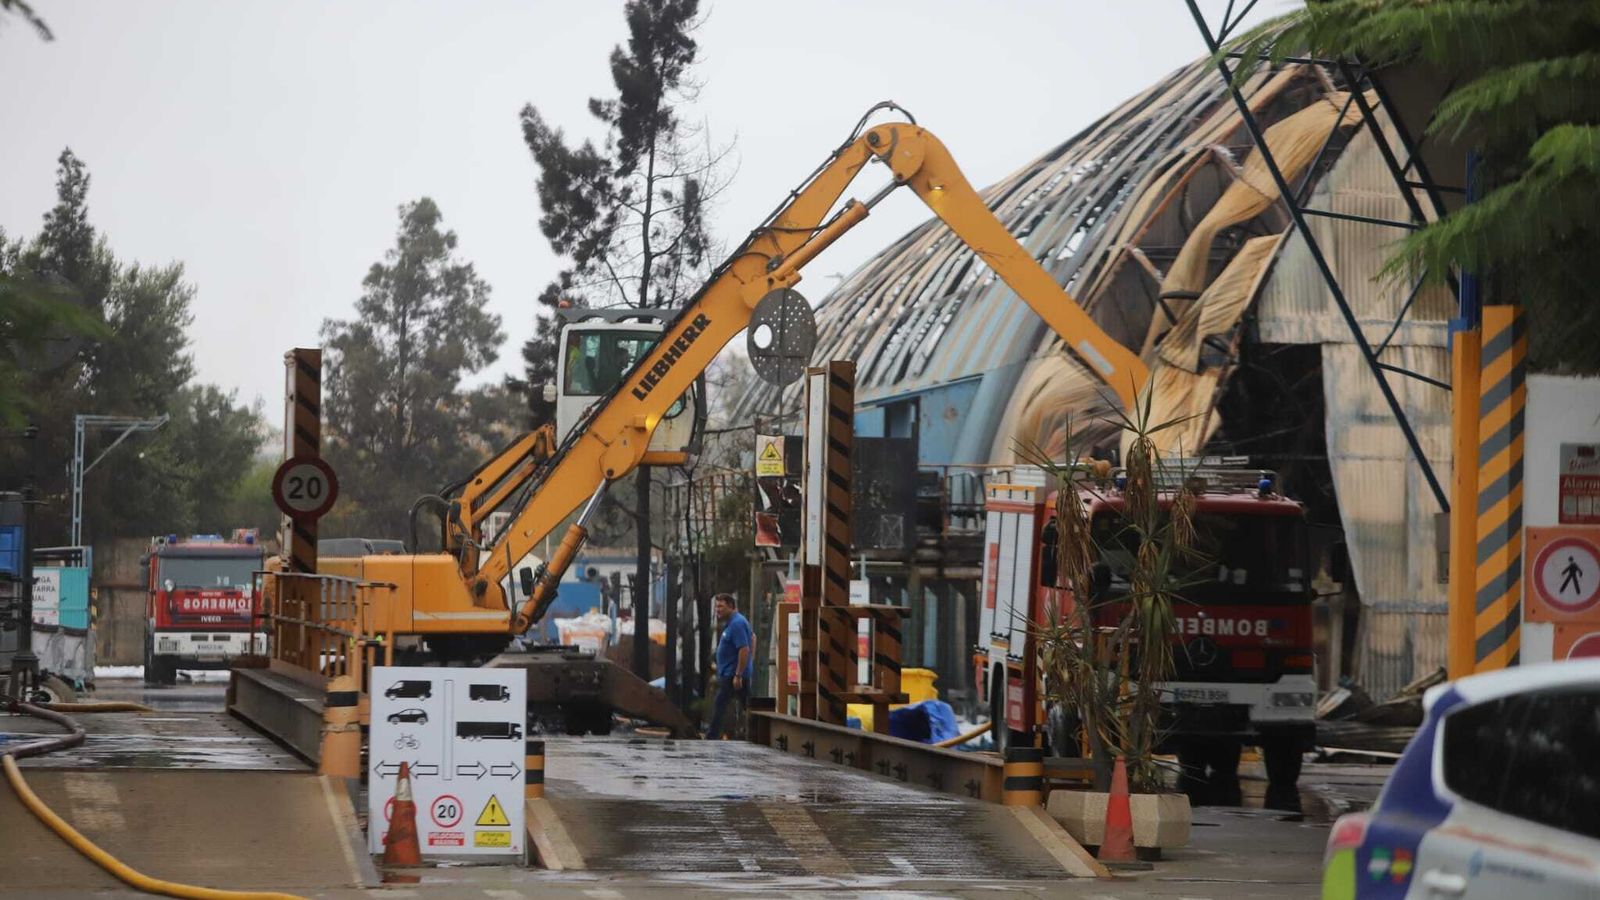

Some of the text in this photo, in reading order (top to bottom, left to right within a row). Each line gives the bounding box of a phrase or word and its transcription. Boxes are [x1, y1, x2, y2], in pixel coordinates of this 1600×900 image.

[631, 313, 712, 401] LIEBHERR
[288, 476, 321, 499] 20
[201, 615, 221, 623] IVECO
[437, 804, 457, 819] 20
